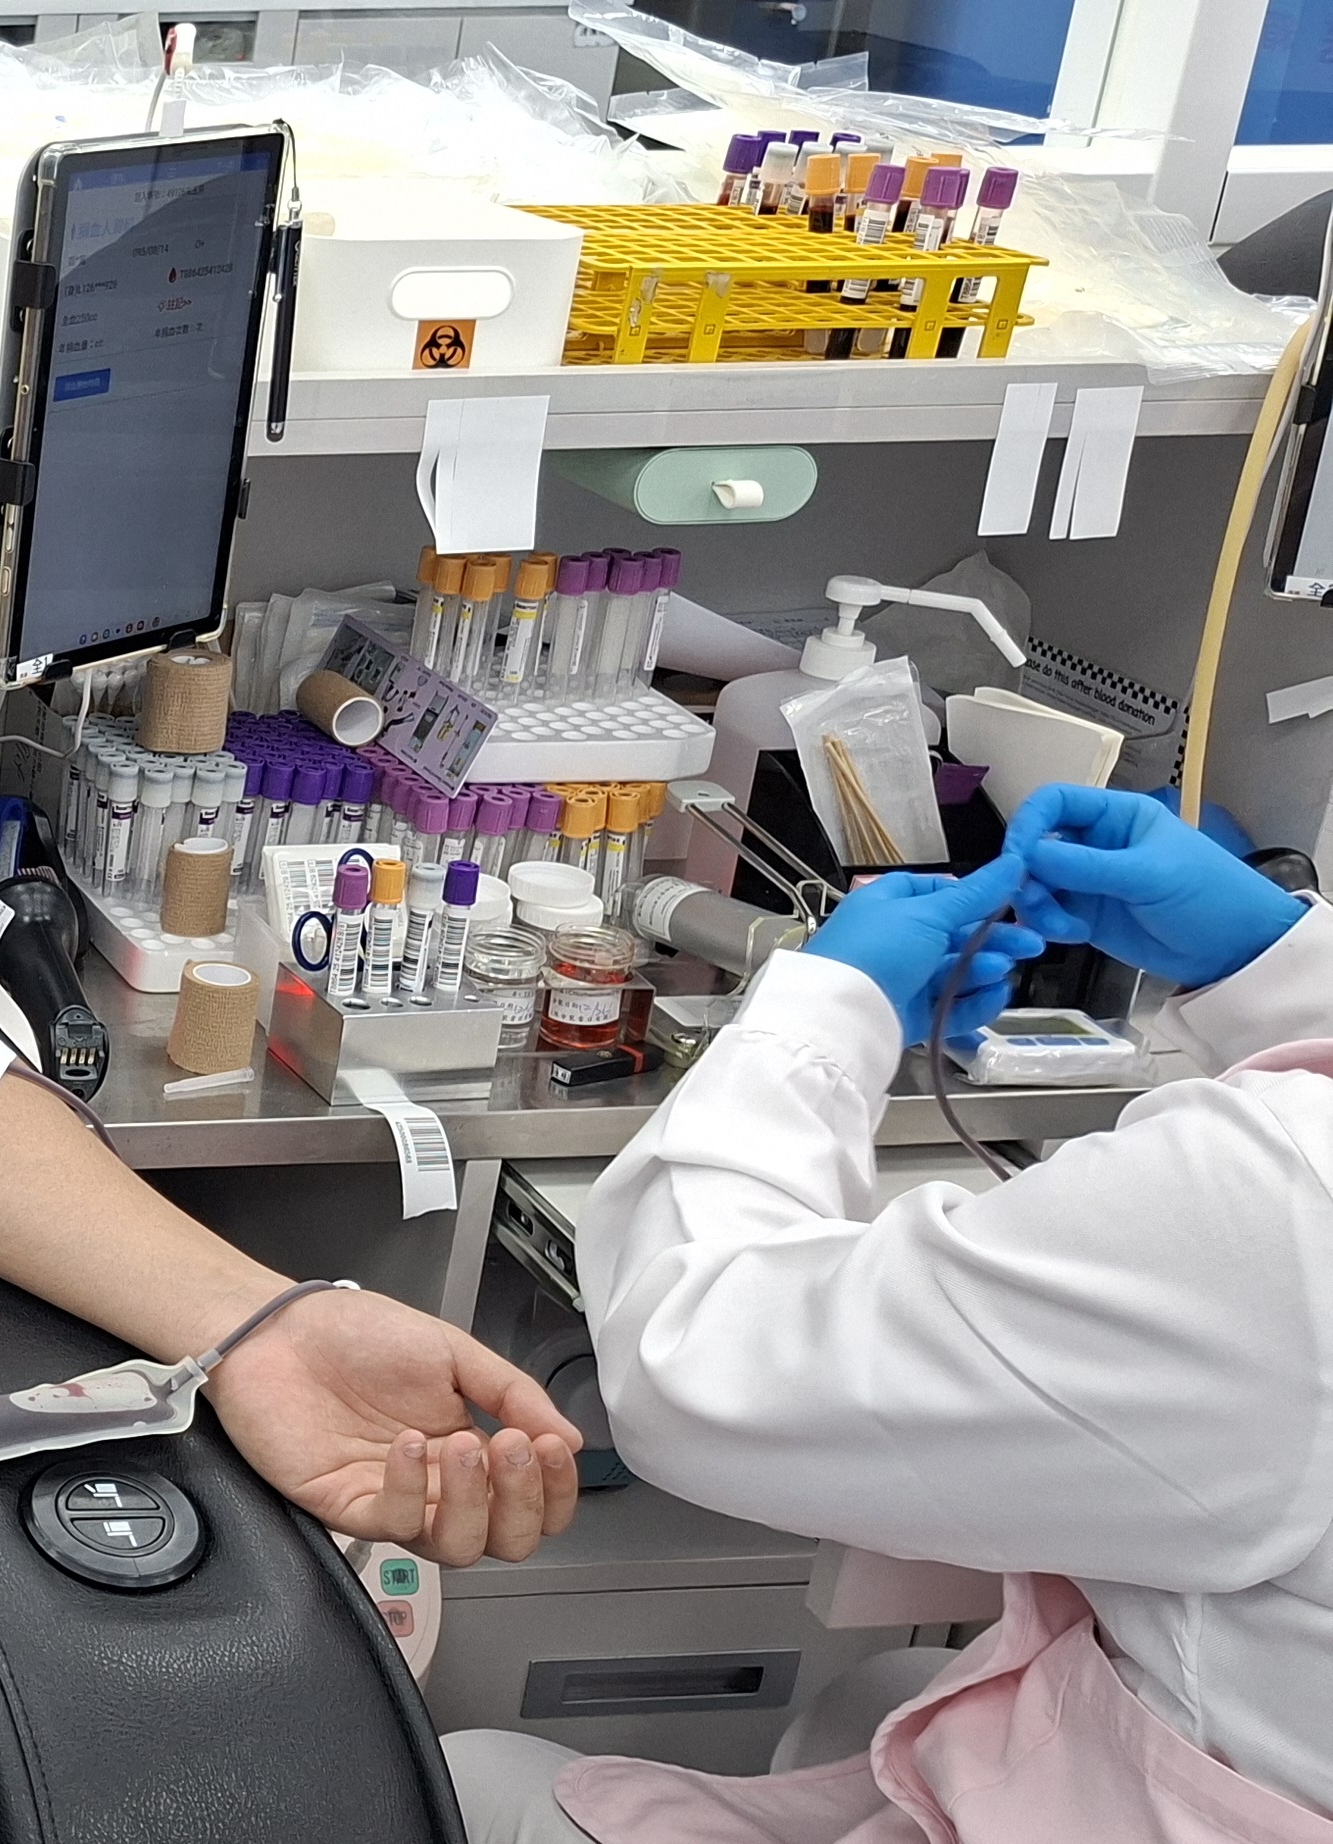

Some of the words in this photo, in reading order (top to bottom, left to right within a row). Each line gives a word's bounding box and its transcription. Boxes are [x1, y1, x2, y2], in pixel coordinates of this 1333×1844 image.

[1042, 664, 1052, 677] do
[1054, 669, 1069, 686] this
[1071, 679, 1093, 696] after
[1094, 686, 1118, 708] blood
[1118, 699, 1156, 727] donation
[383, 1568, 415, 1585] START
[383, 1610, 407, 1626] TOP
